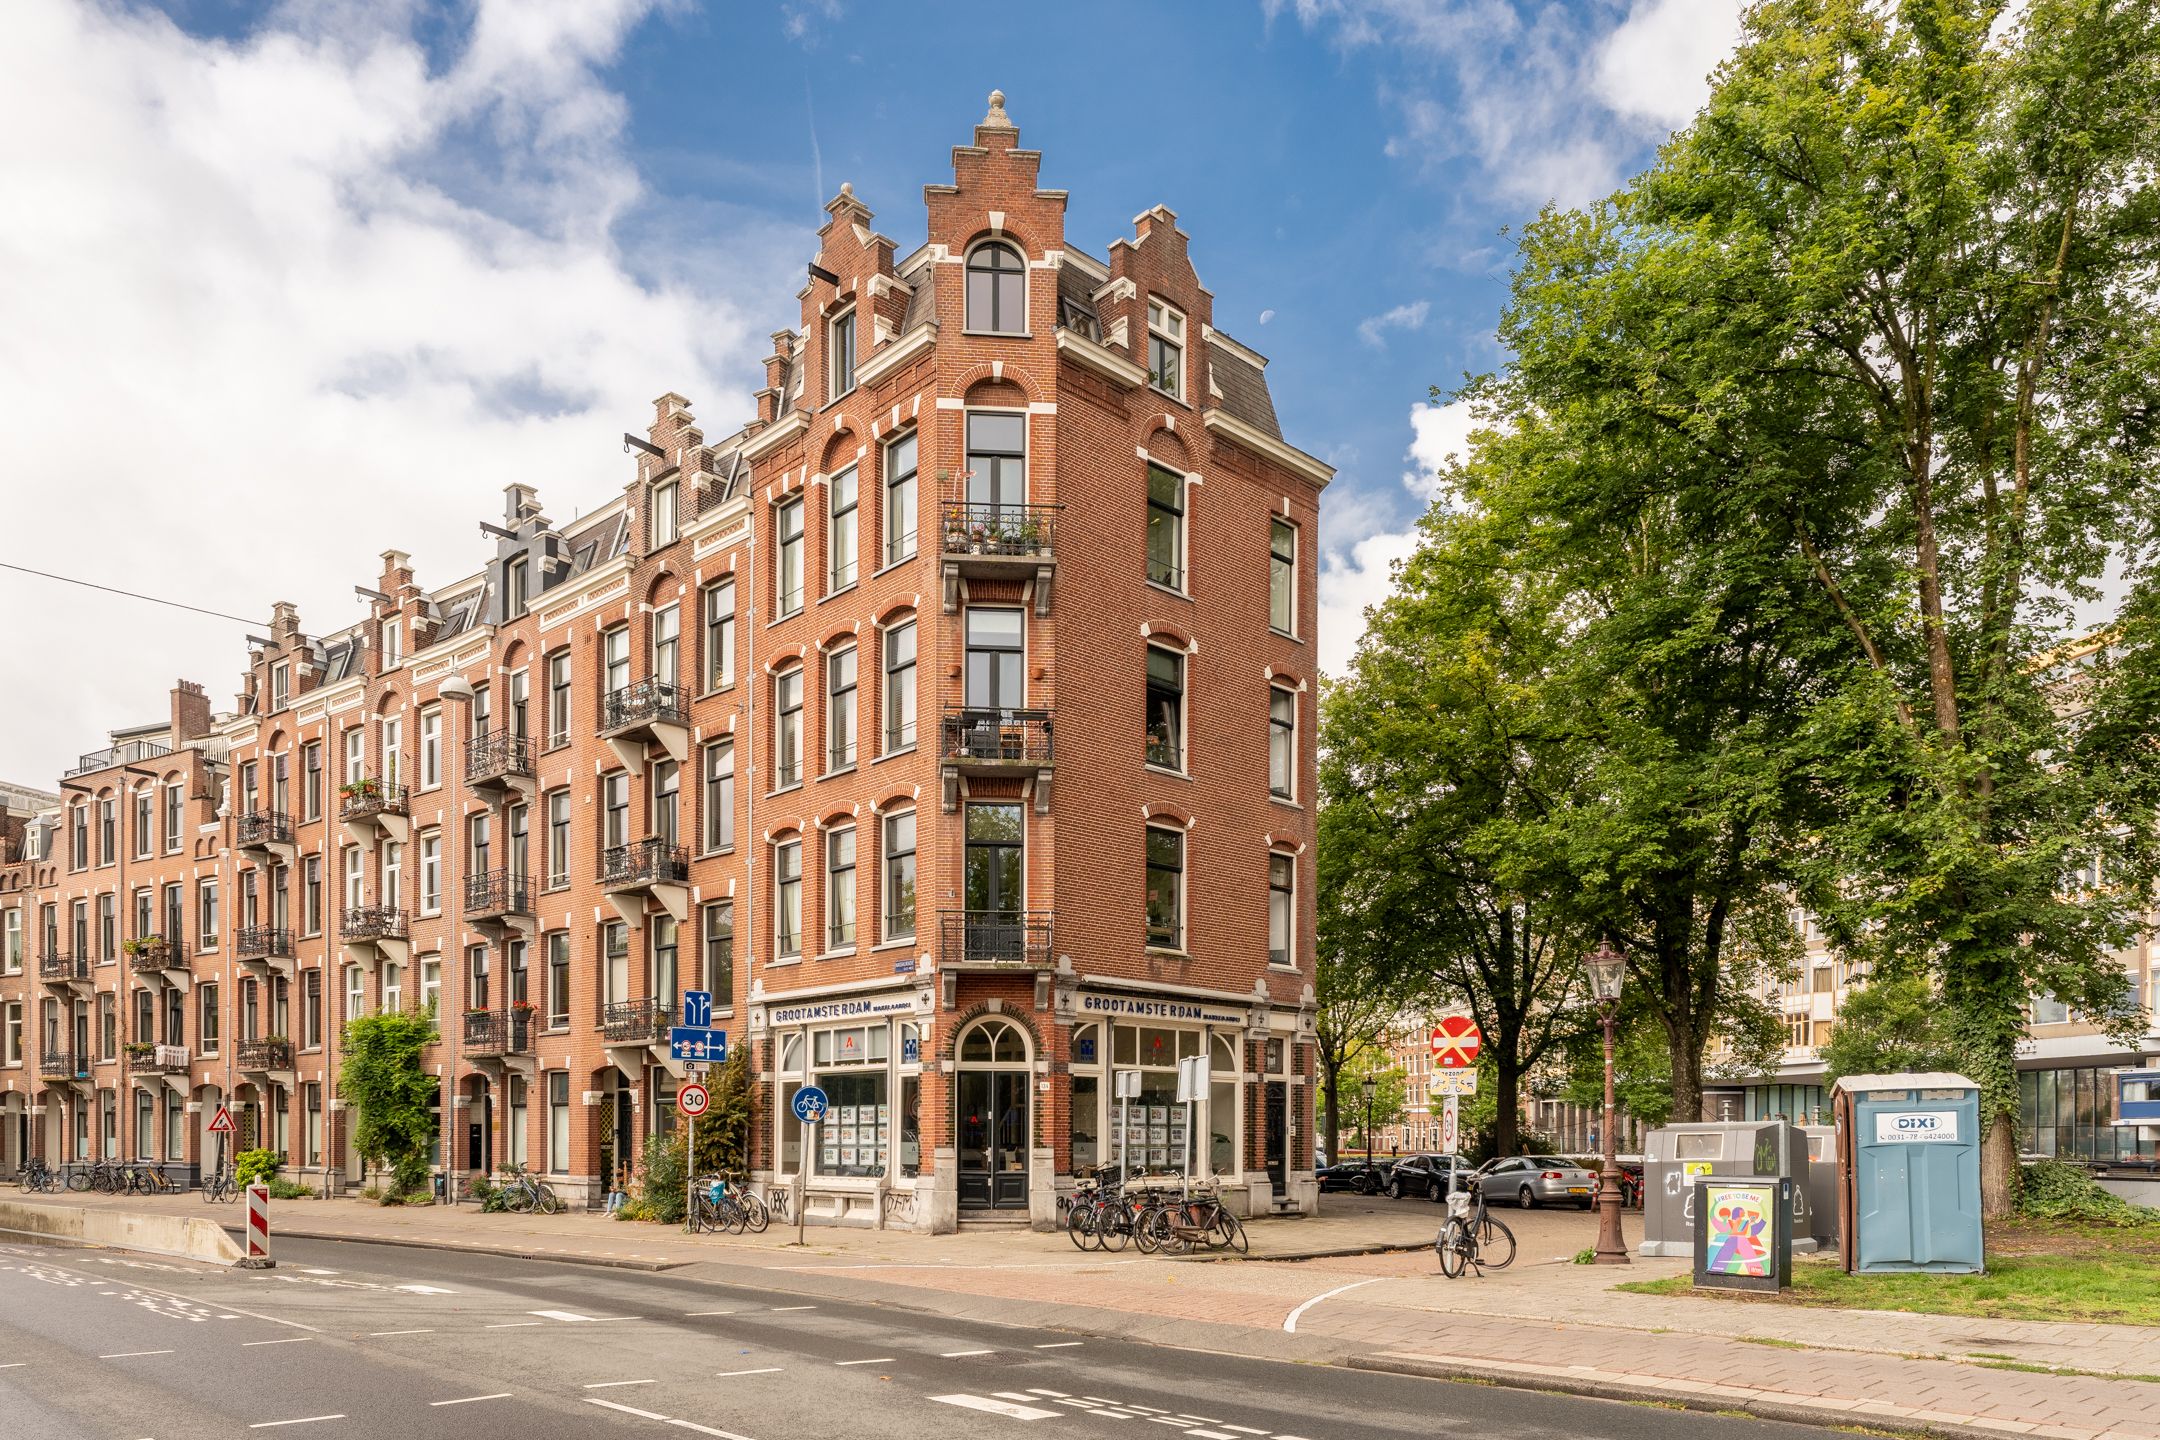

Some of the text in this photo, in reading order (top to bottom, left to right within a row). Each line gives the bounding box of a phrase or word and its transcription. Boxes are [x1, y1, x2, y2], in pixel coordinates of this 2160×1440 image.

[776, 1001, 871, 1021] GROOTAMSTERDAM
[1085, 997, 1201, 1019] GROOTAMSTERDAM
[685, 1094, 704, 1106] 30
